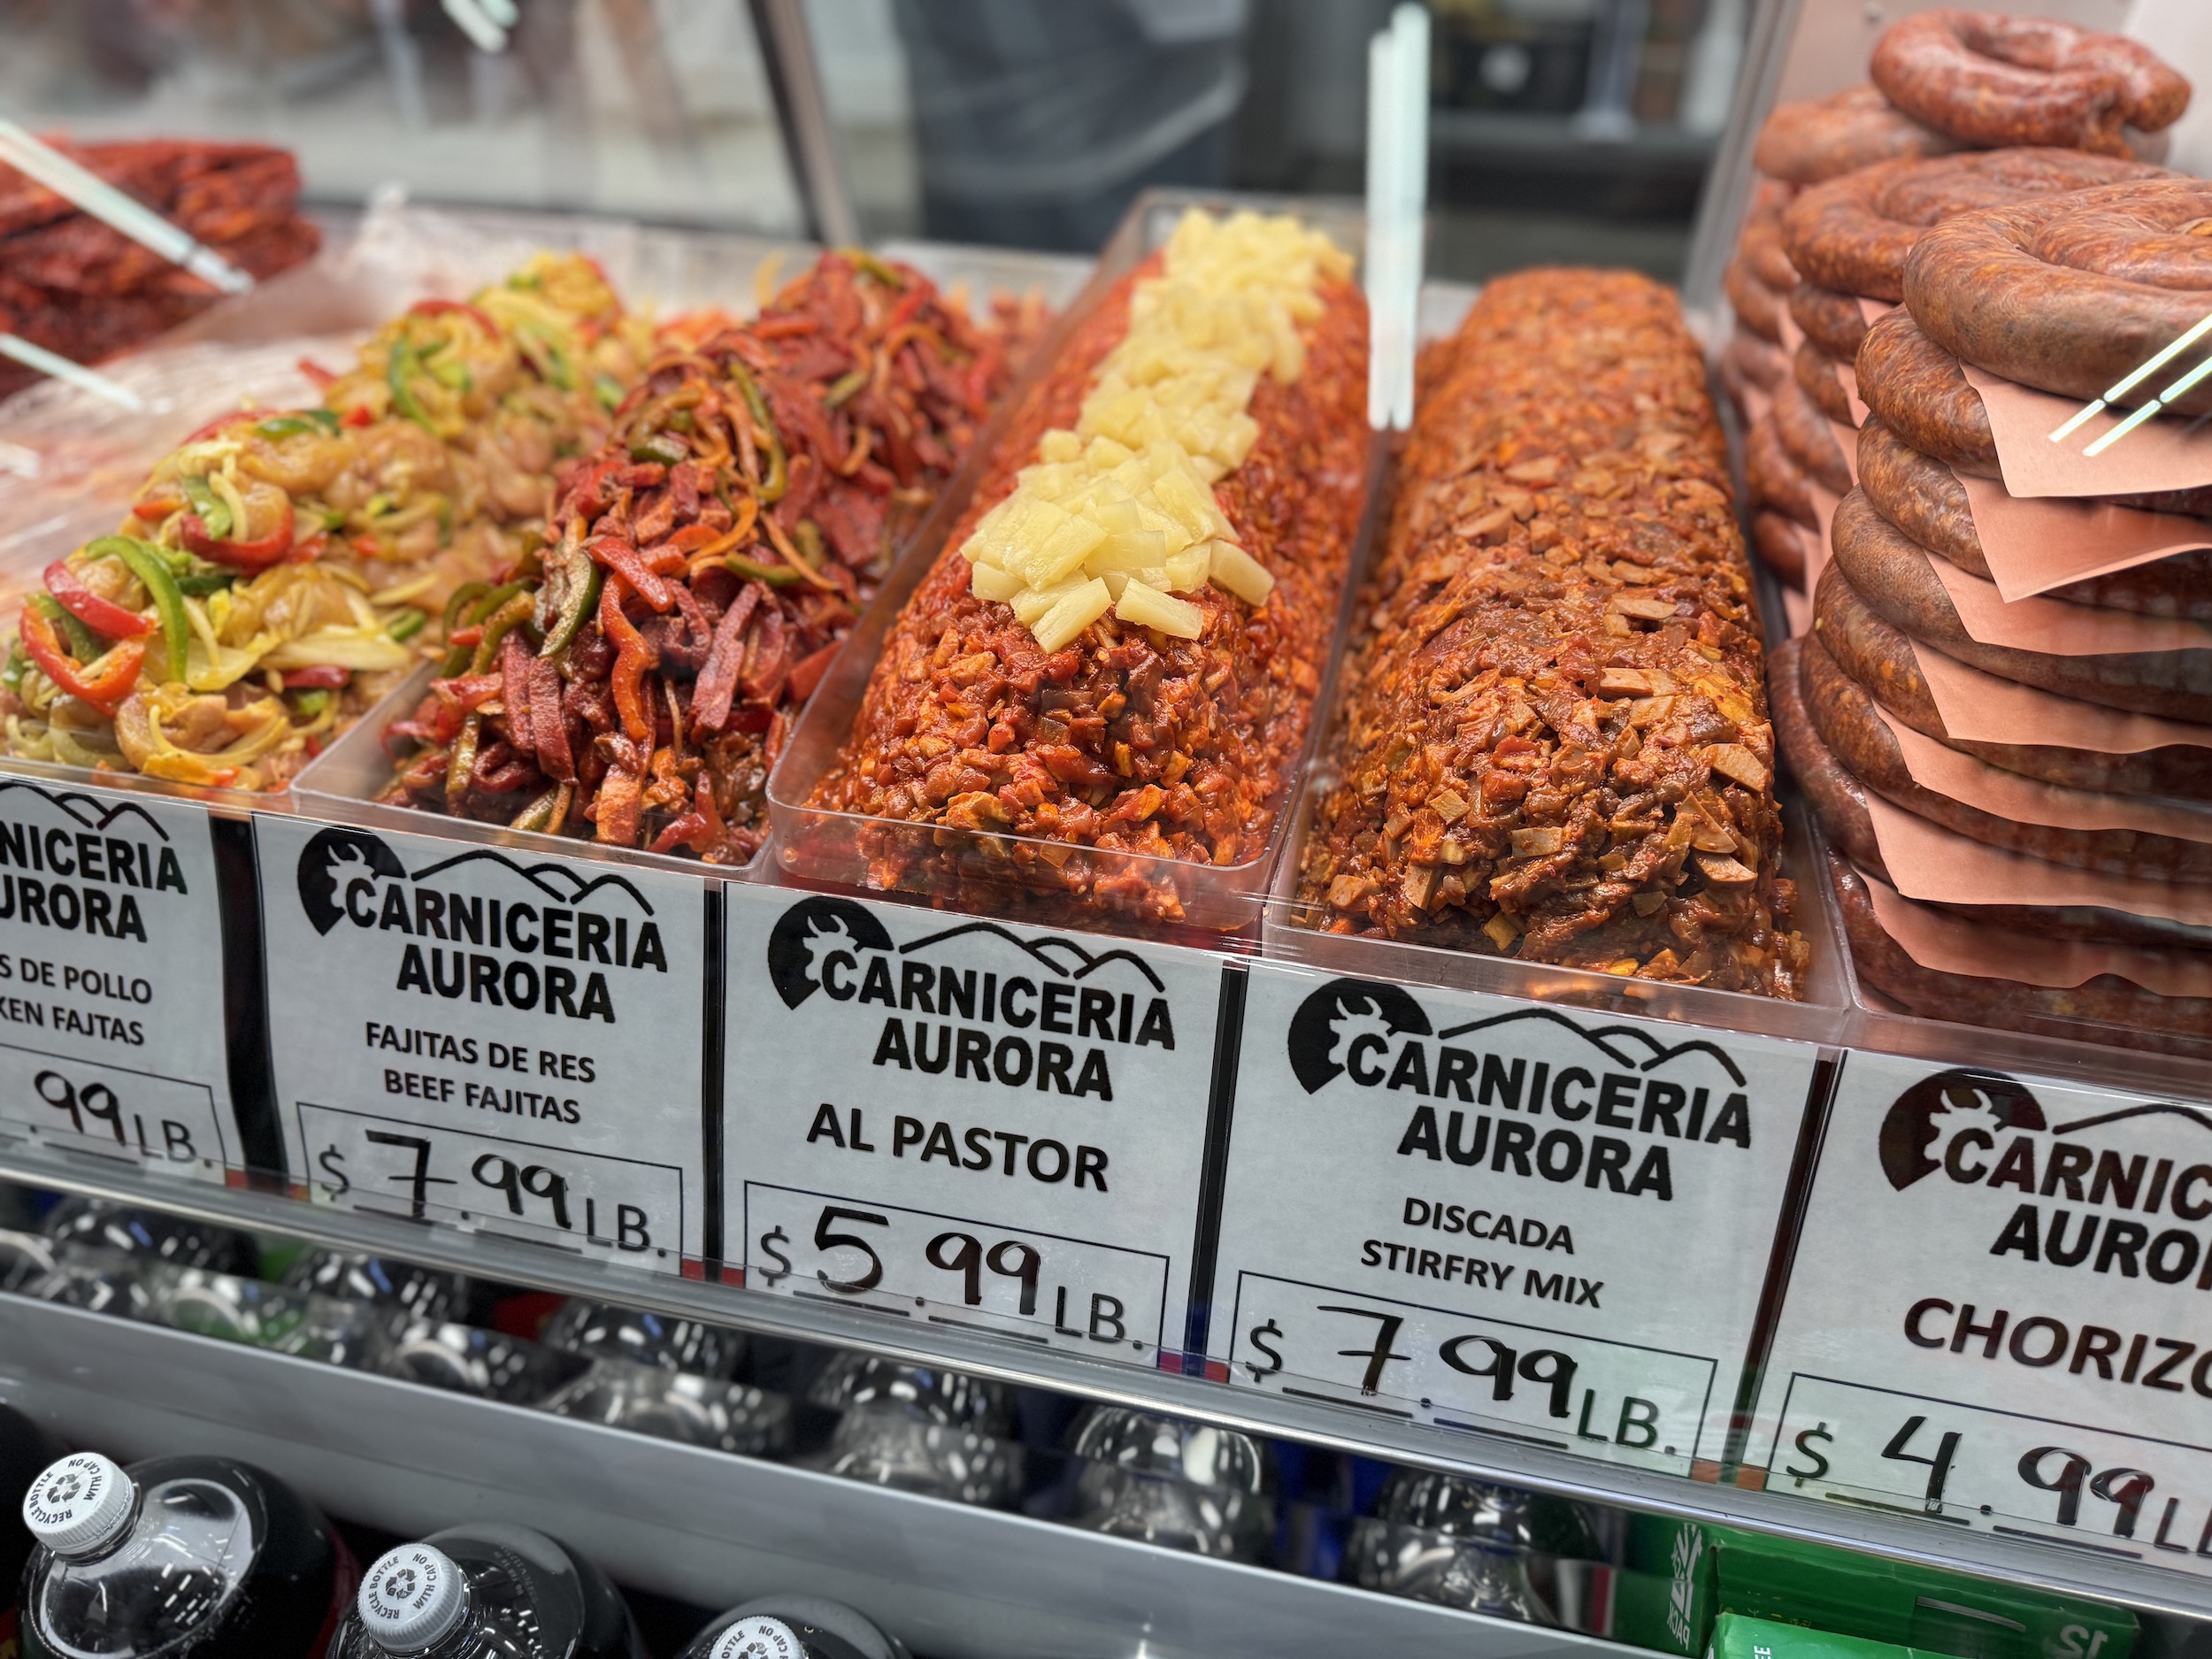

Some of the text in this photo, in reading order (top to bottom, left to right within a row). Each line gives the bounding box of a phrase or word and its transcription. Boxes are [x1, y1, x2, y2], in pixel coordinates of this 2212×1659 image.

[0, 820, 188, 895] NICERIA
[345, 878, 668, 972] CARNICERIA
[20, 958, 56, 987] DE
[64, 966, 152, 1004] POLLO
[396, 943, 615, 1024] AURORA
[822, 949, 1175, 1050] CARNICERIA
[52, 1006, 144, 1046] FAJTAS
[365, 1022, 595, 1083] FAJITAS DE RES
[872, 1018, 1113, 1102] AURORA
[1347, 1033, 1752, 1148] CARNICERIA
[385, 1069, 580, 1124] BEEF FAJITAS
[134, 1114, 212, 1168] LB.
[807, 1103, 1109, 1192] AL PASTOR
[1397, 1105, 1672, 1201] AURORA
[1945, 1128, 2212, 1221] CARNIC
[585, 1198, 667, 1257] LB.
[1403, 1198, 1574, 1255] DISCADA
[1362, 1240, 1604, 1308] STIRFRY MIX
[1055, 1286, 1142, 1350] LB.
[1578, 1389, 1676, 1455] LB.
[29, 1471, 73, 1524] RECYCLE BOTTLE
[68, 1458, 102, 1501] WITH CAP ON
[368, 1555, 400, 1619] RECYCLE BOTTLE
[412, 1553, 437, 1609] WITH CAP ON
[758, 1625, 787, 1653] CAP ON
